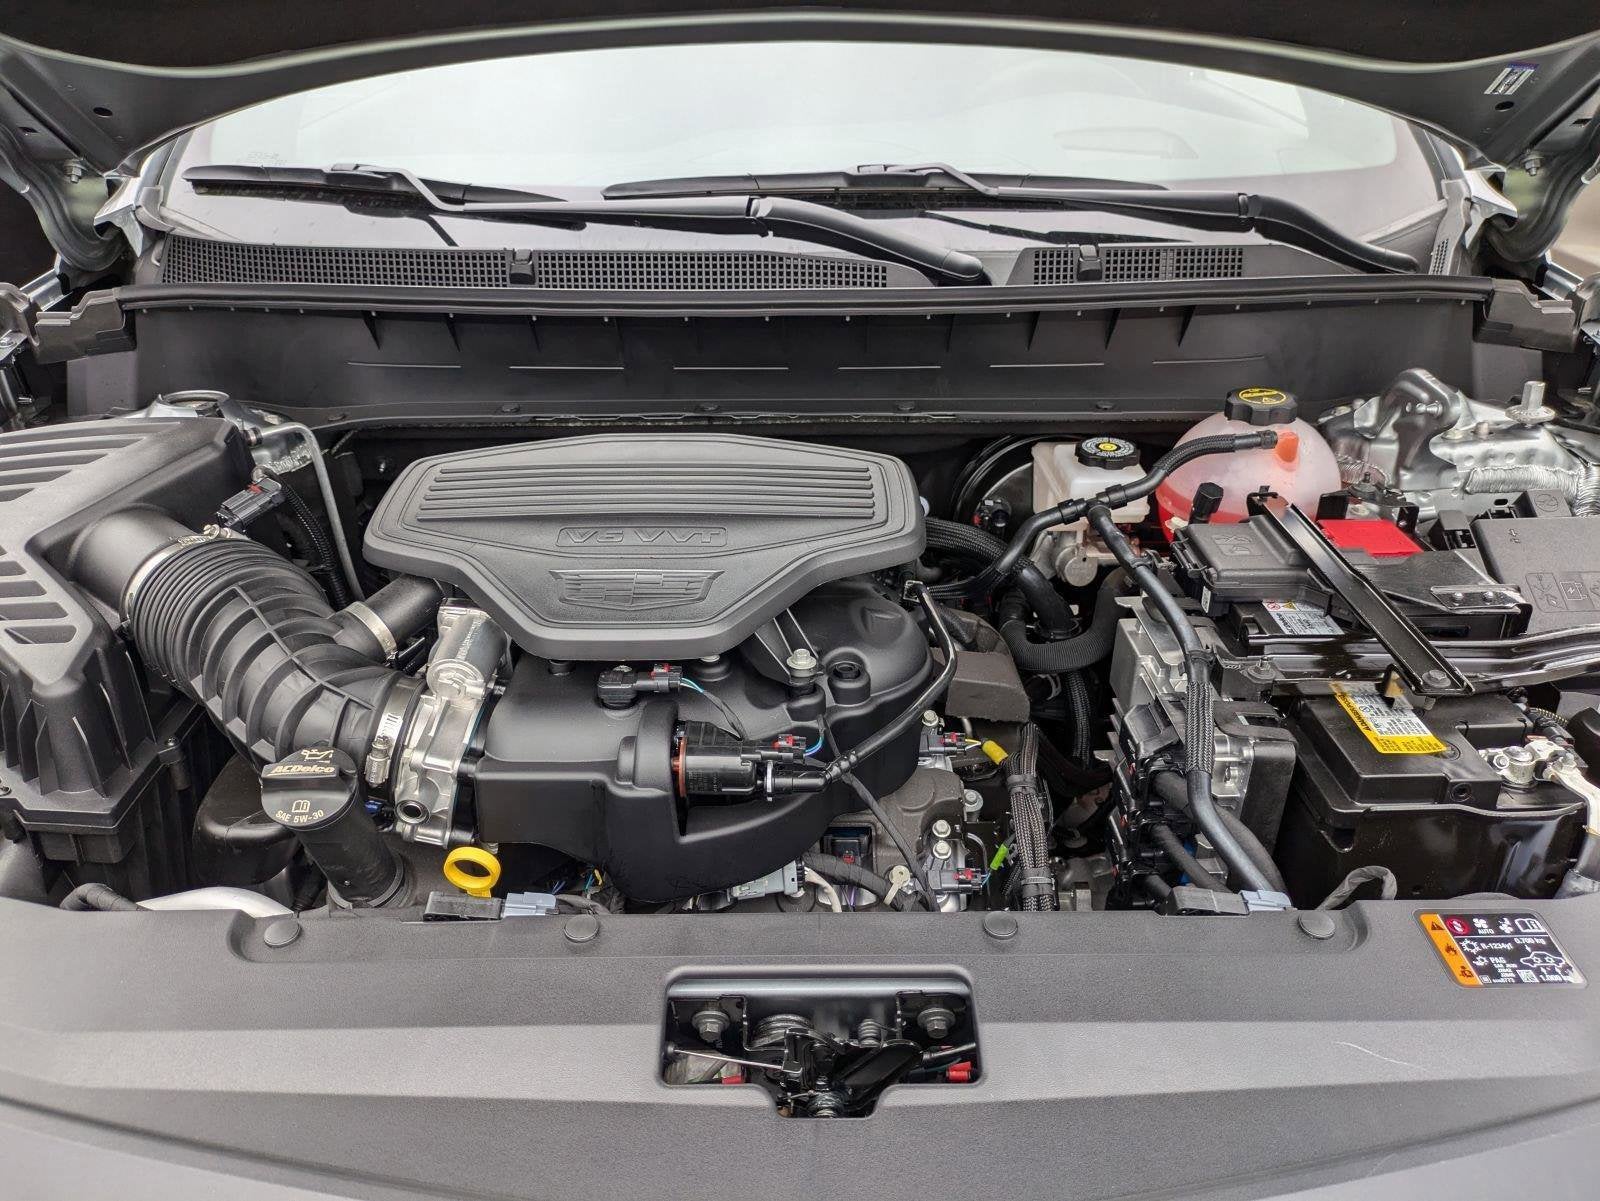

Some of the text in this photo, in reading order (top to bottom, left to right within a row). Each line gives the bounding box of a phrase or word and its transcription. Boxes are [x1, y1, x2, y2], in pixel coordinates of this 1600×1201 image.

[565, 529, 722, 543] V6 VVT
[270, 764, 335, 774] ACDelco
[275, 809, 325, 823] SAE 5W-30
[1489, 956, 1507, 964] PAG
